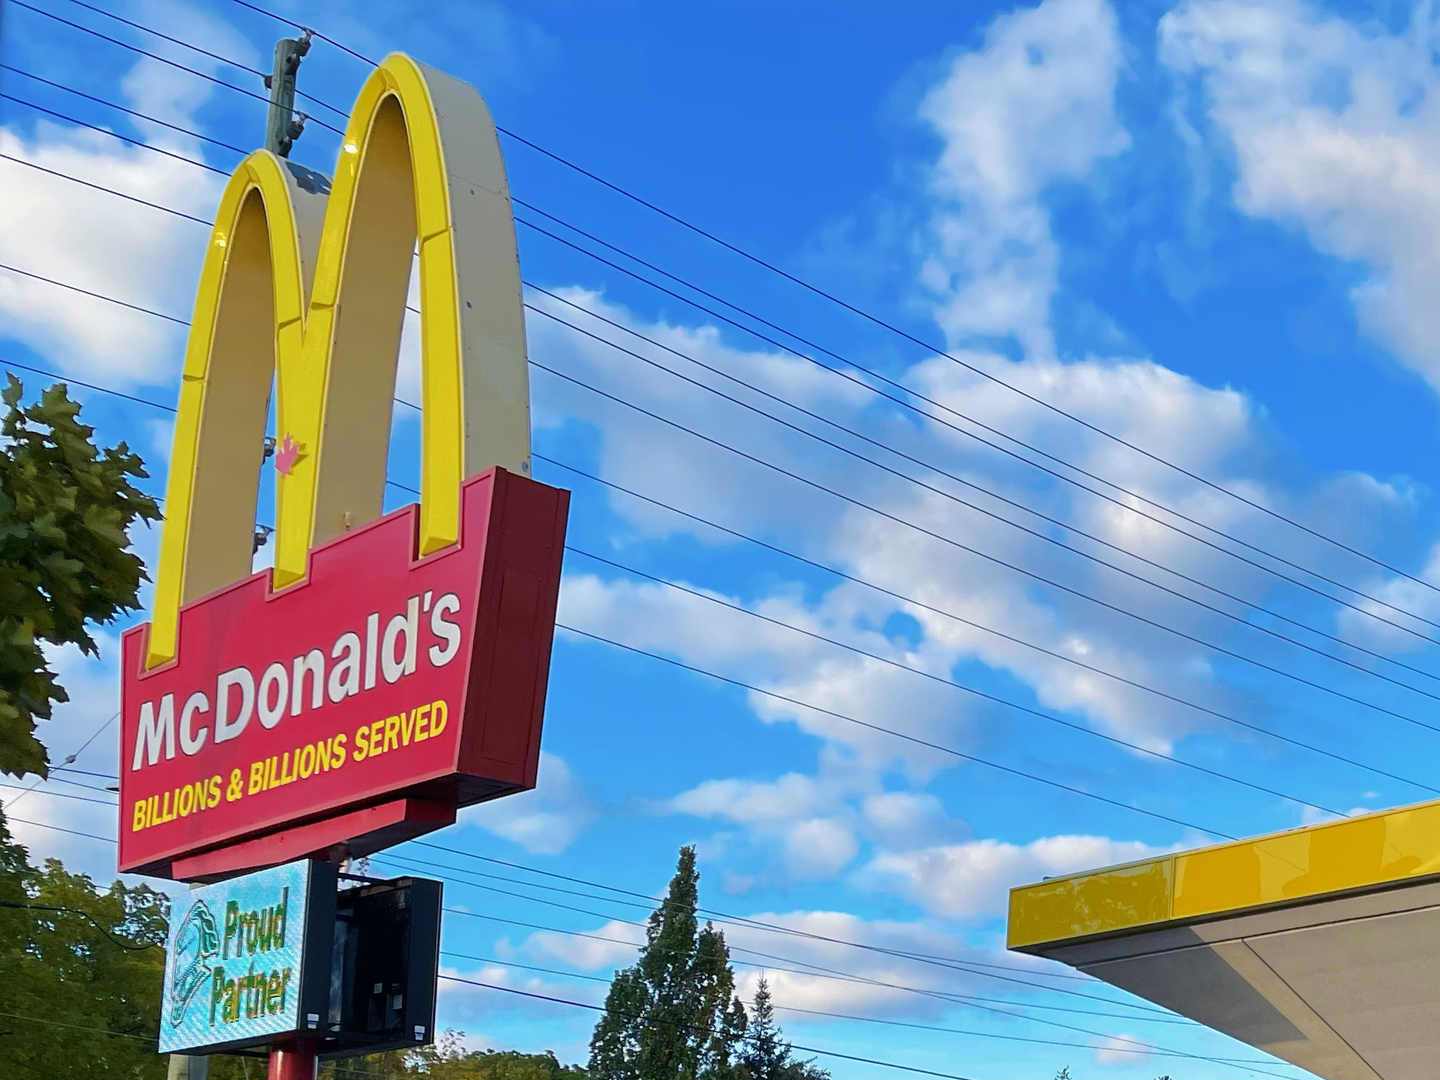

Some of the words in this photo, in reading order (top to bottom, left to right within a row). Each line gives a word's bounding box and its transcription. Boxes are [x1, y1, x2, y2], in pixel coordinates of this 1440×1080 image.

[131, 590, 462, 772] McDonald's
[132, 775, 222, 832] BILLIONS
[225, 768, 244, 803] &
[247, 734, 347, 796] BILLIONS
[352, 699, 449, 762] SERVED
[222, 887, 290, 960] Proud
[208, 962, 292, 1027] Partner
